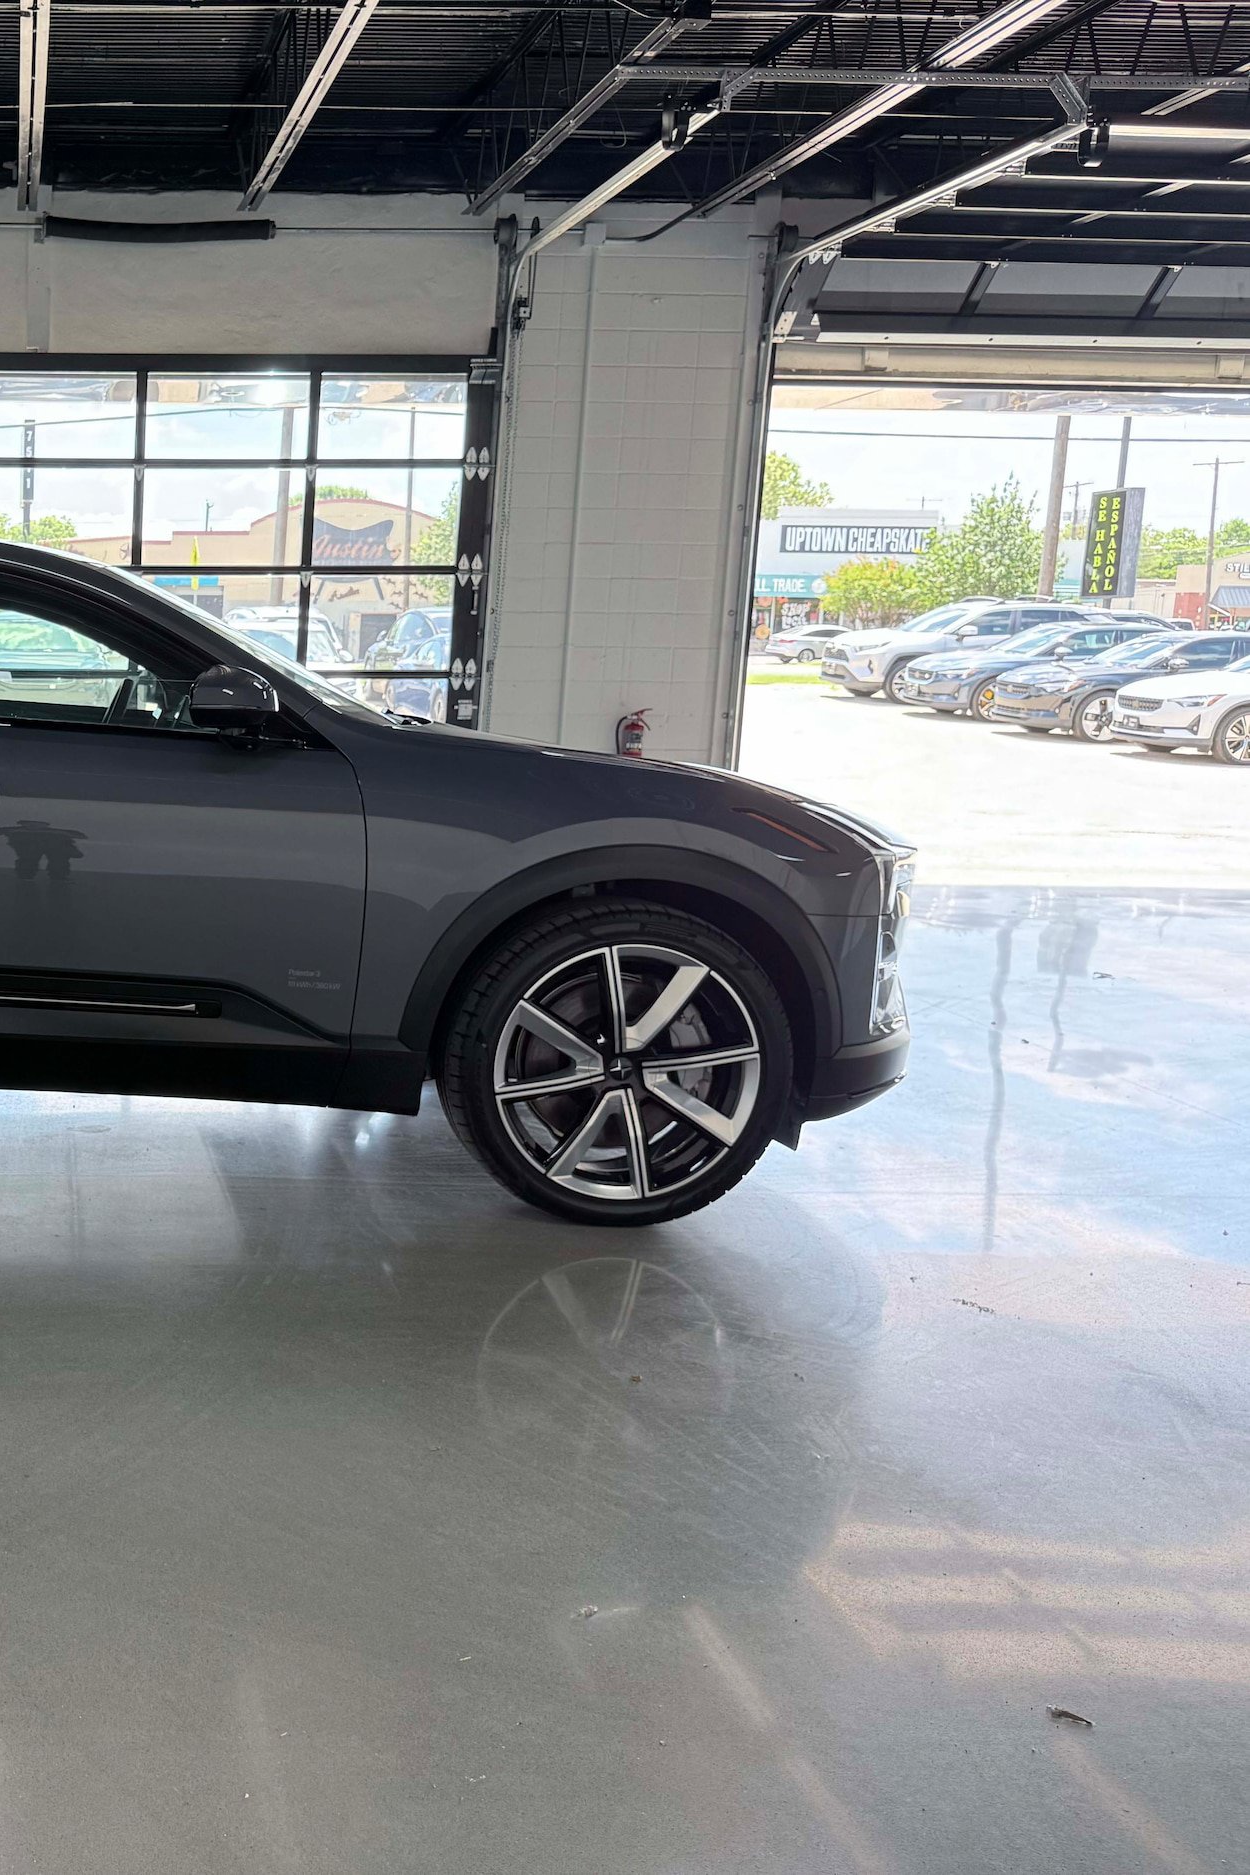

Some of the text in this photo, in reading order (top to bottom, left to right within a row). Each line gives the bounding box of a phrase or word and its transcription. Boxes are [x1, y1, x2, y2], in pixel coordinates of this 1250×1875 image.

[785, 527, 930, 553] UPTOWN CHEAPSKATE
[1089, 496, 1108, 594] SE HABLA
[1103, 497, 1121, 591] ESPAÑOL
